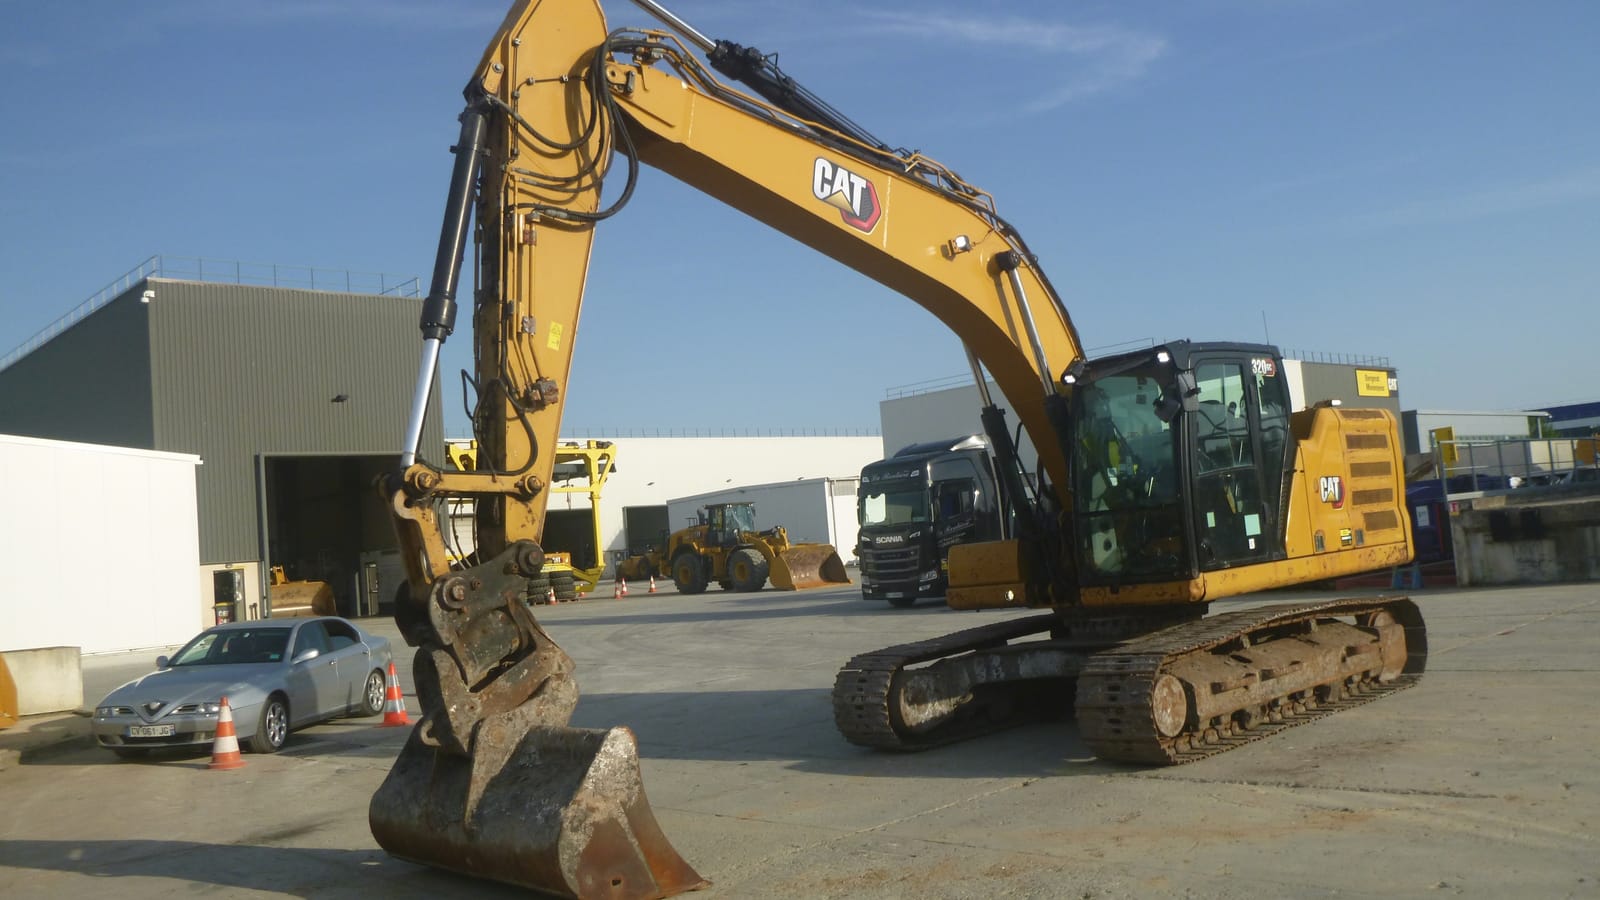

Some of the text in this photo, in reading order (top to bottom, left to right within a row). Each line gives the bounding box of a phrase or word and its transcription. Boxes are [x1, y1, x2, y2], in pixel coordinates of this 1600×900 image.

[813, 157, 867, 217] CAT
[1251, 358, 1267, 375] 320
[1320, 476, 1340, 503] CAT
[875, 535, 904, 544] SCANIA
